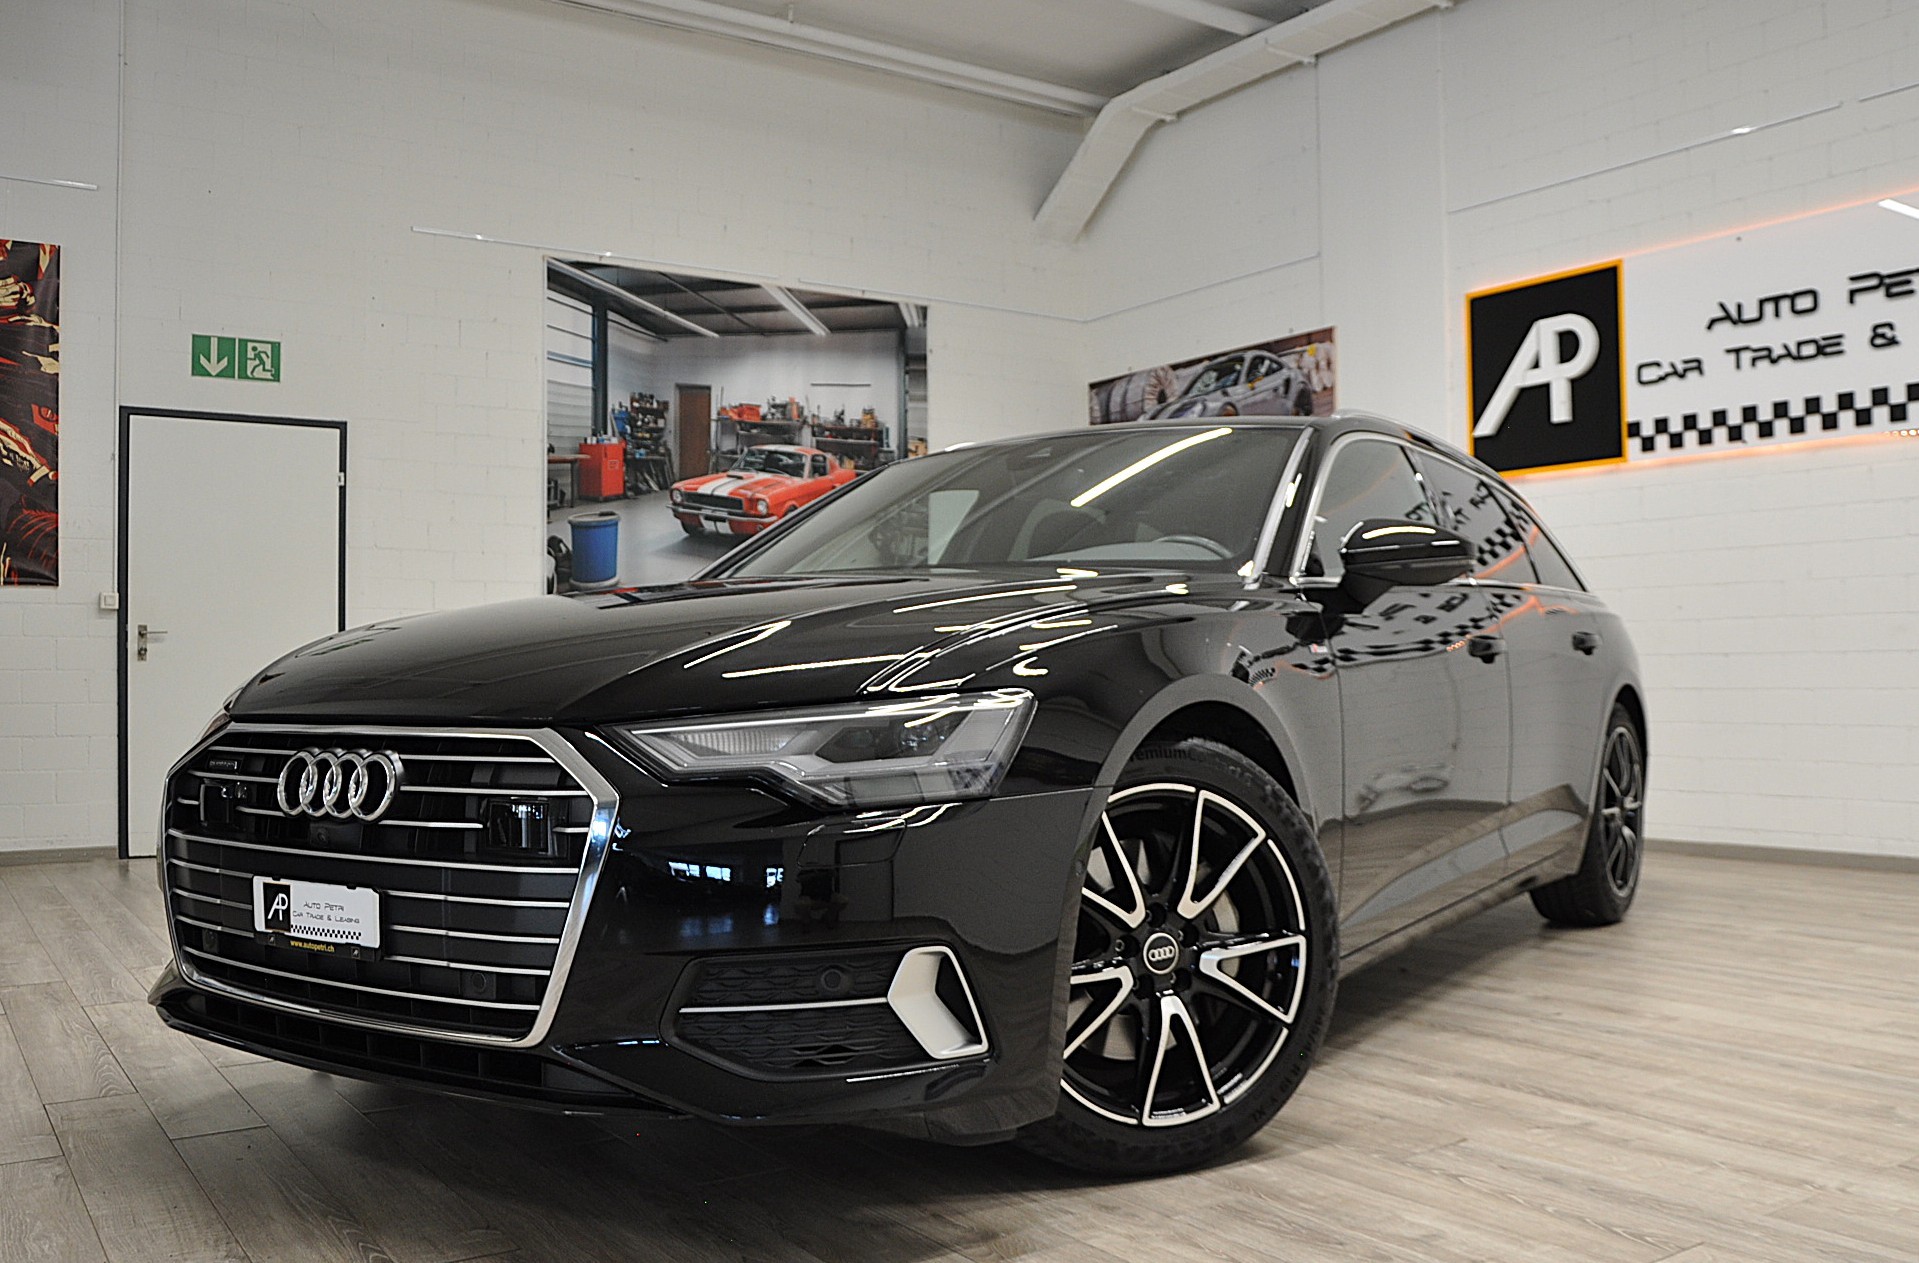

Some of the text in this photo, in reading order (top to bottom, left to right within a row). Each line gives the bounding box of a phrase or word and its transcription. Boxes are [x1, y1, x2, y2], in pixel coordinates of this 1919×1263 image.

[1848, 267, 1919, 304] PE
[1869, 321, 1901, 349] &
[1473, 312, 1600, 438] AP
[267, 892, 289, 921] AP
[290, 940, 335, 953] www.autopetri.ch
